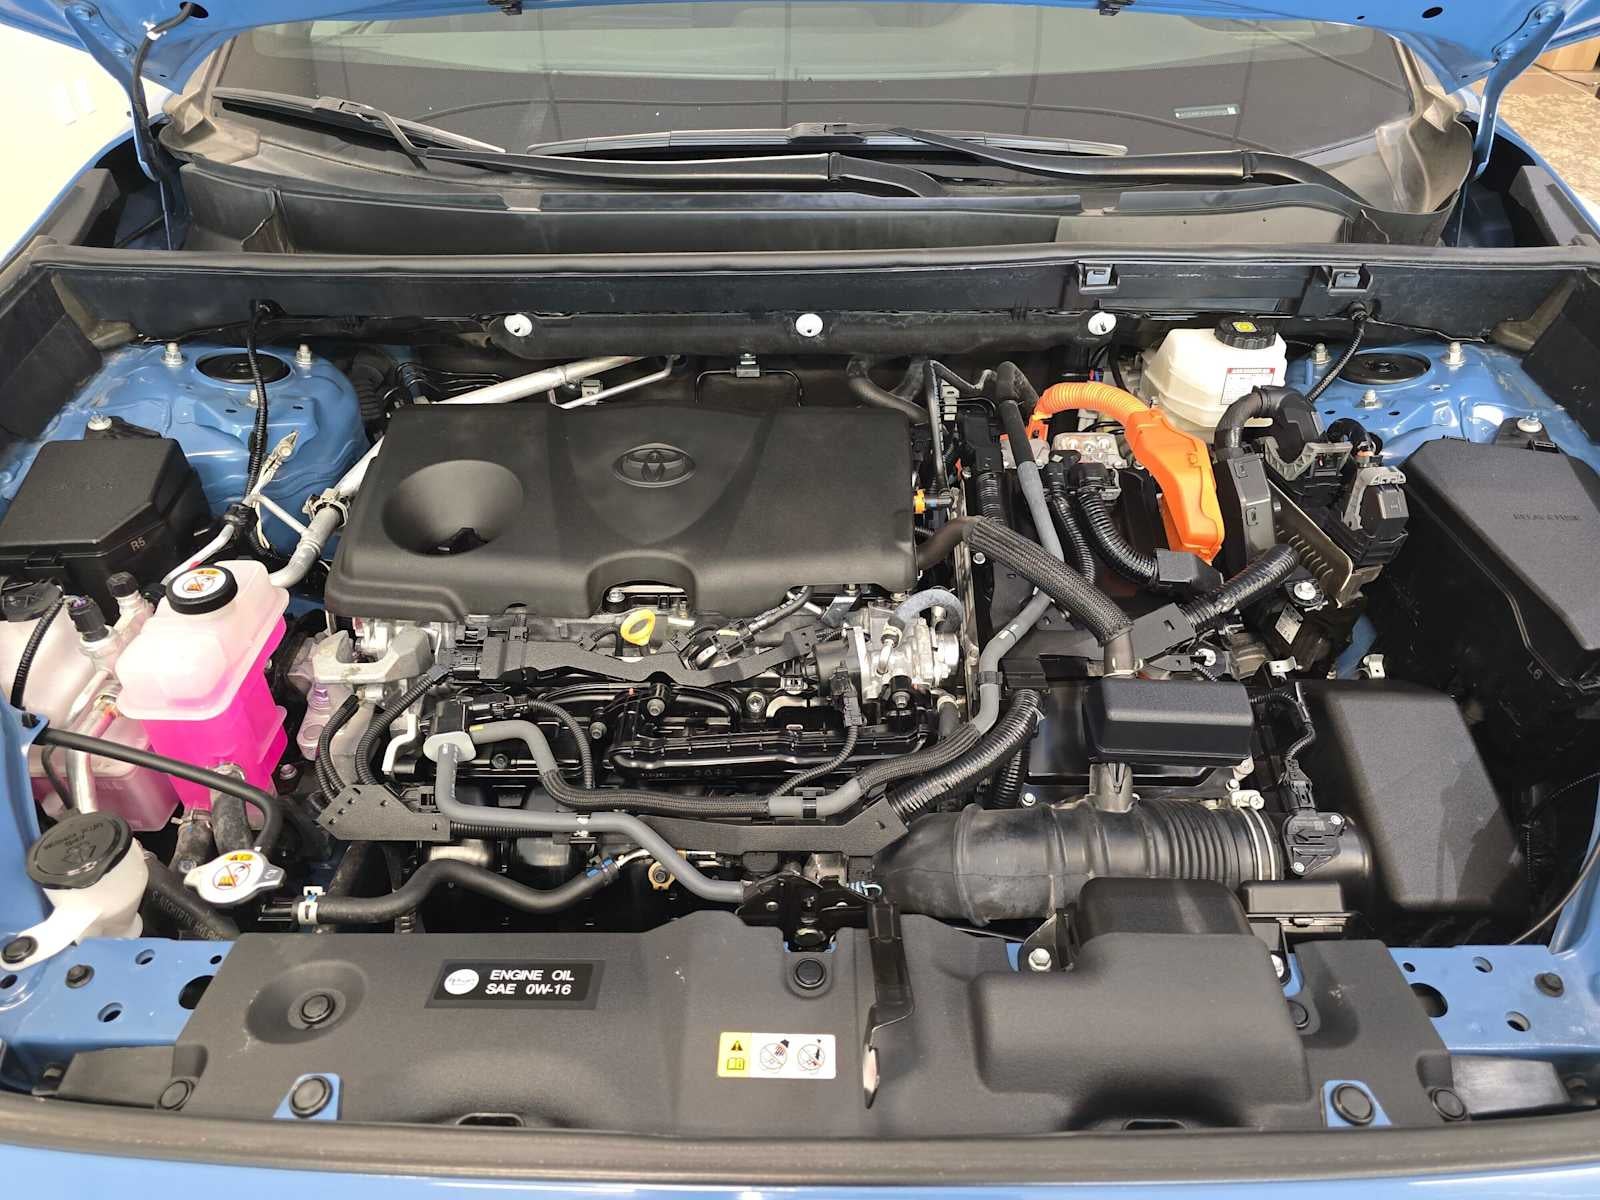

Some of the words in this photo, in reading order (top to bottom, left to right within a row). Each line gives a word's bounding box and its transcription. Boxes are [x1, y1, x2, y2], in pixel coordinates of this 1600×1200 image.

[489, 969, 544, 981] ENGINE
[551, 969, 575, 981] OIL
[485, 983, 516, 995] SAE
[525, 983, 572, 995] 0W-16
